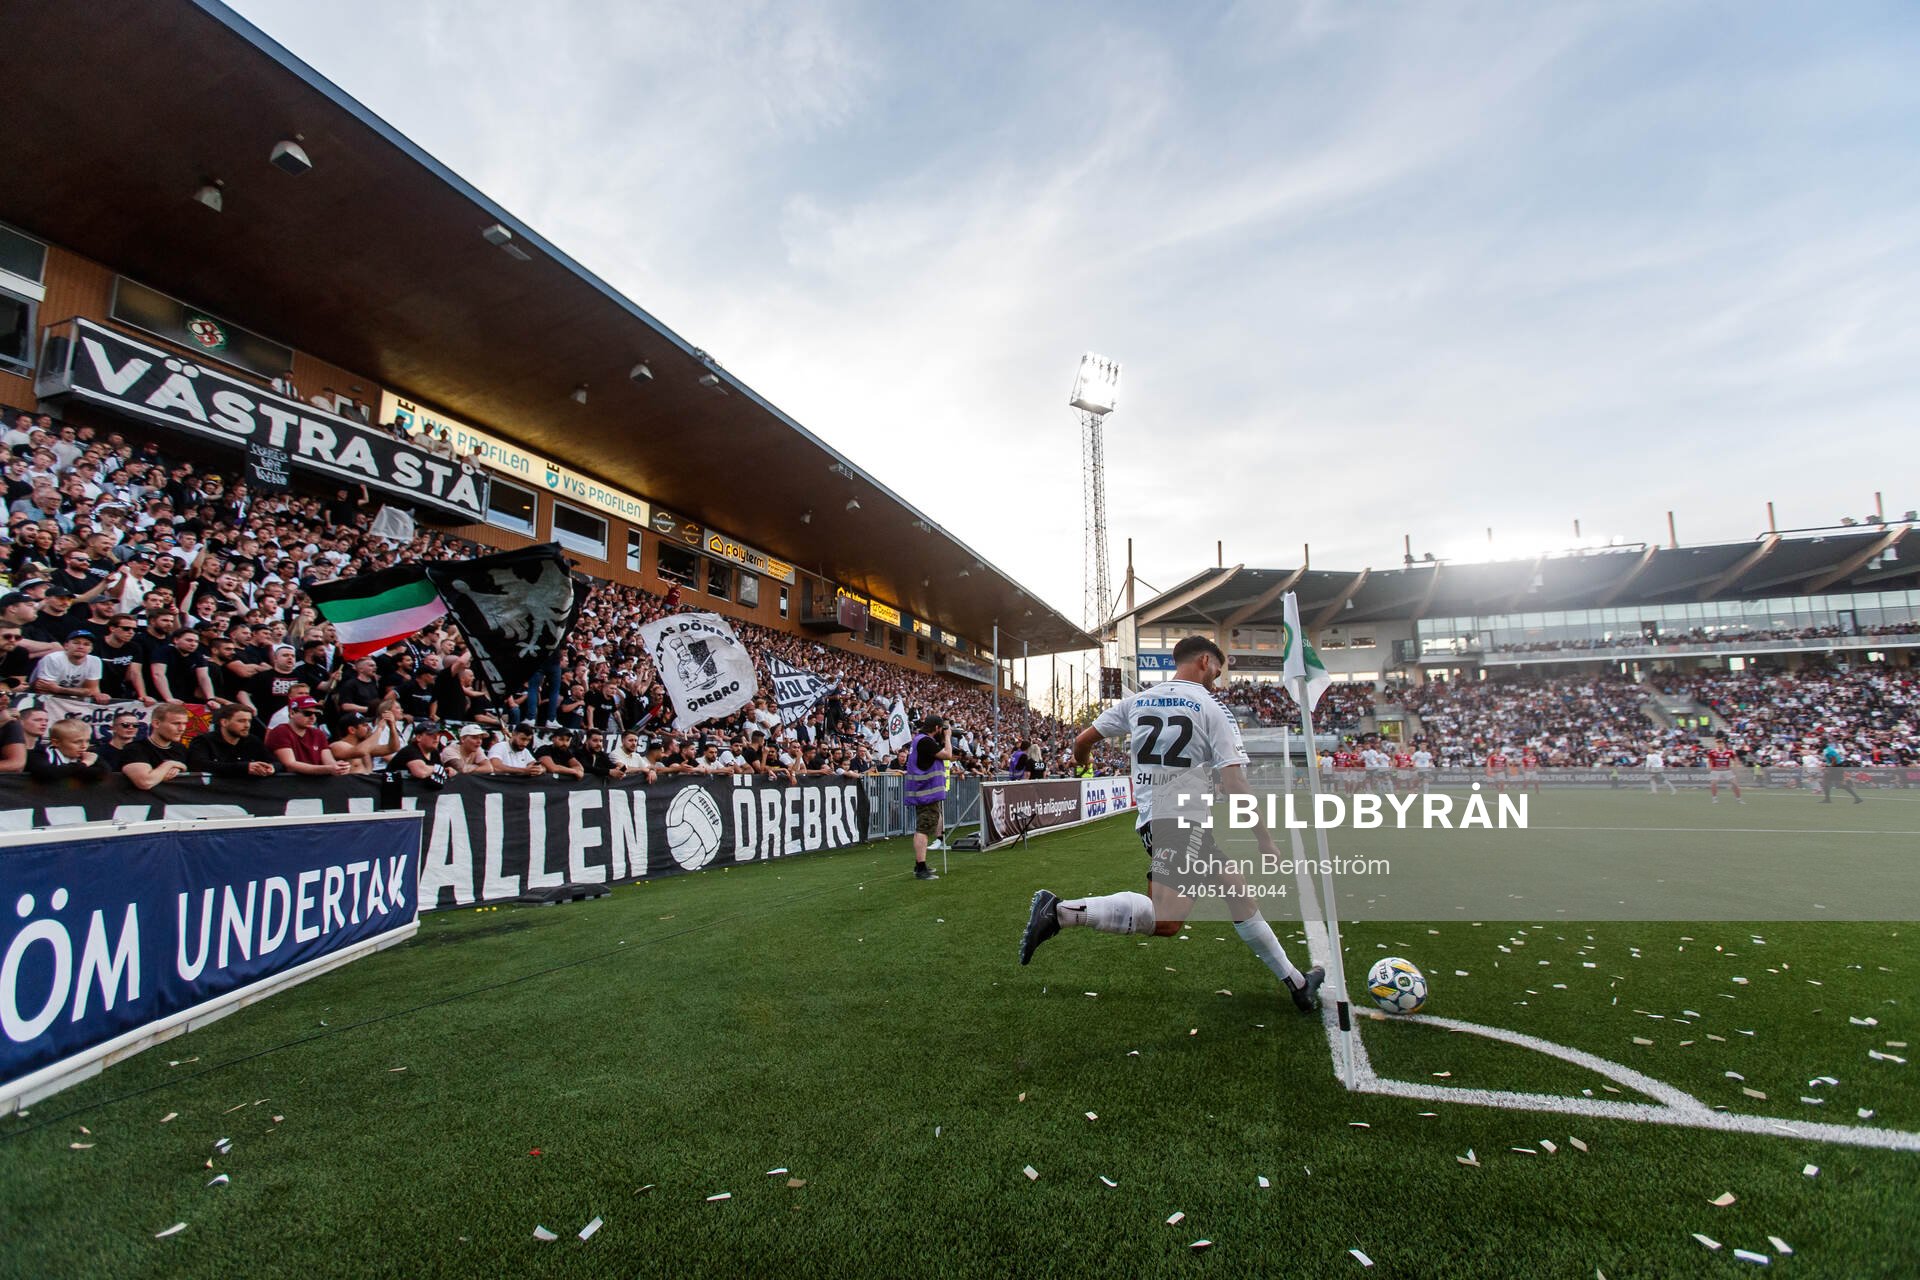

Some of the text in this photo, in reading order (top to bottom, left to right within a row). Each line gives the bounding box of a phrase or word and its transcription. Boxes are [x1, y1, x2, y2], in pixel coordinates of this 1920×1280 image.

[81, 336, 379, 478] VÄSTRA
[391, 451, 481, 512] STÅ
[563, 474, 586, 496] VVS
[1138, 656, 1160, 668] NA
[686, 680, 740, 712] ÖREBRO
[1136, 697, 1201, 712] MALMBERGS
[1137, 715, 1193, 768] 22
[178, 854, 408, 982] UNDERTAK
